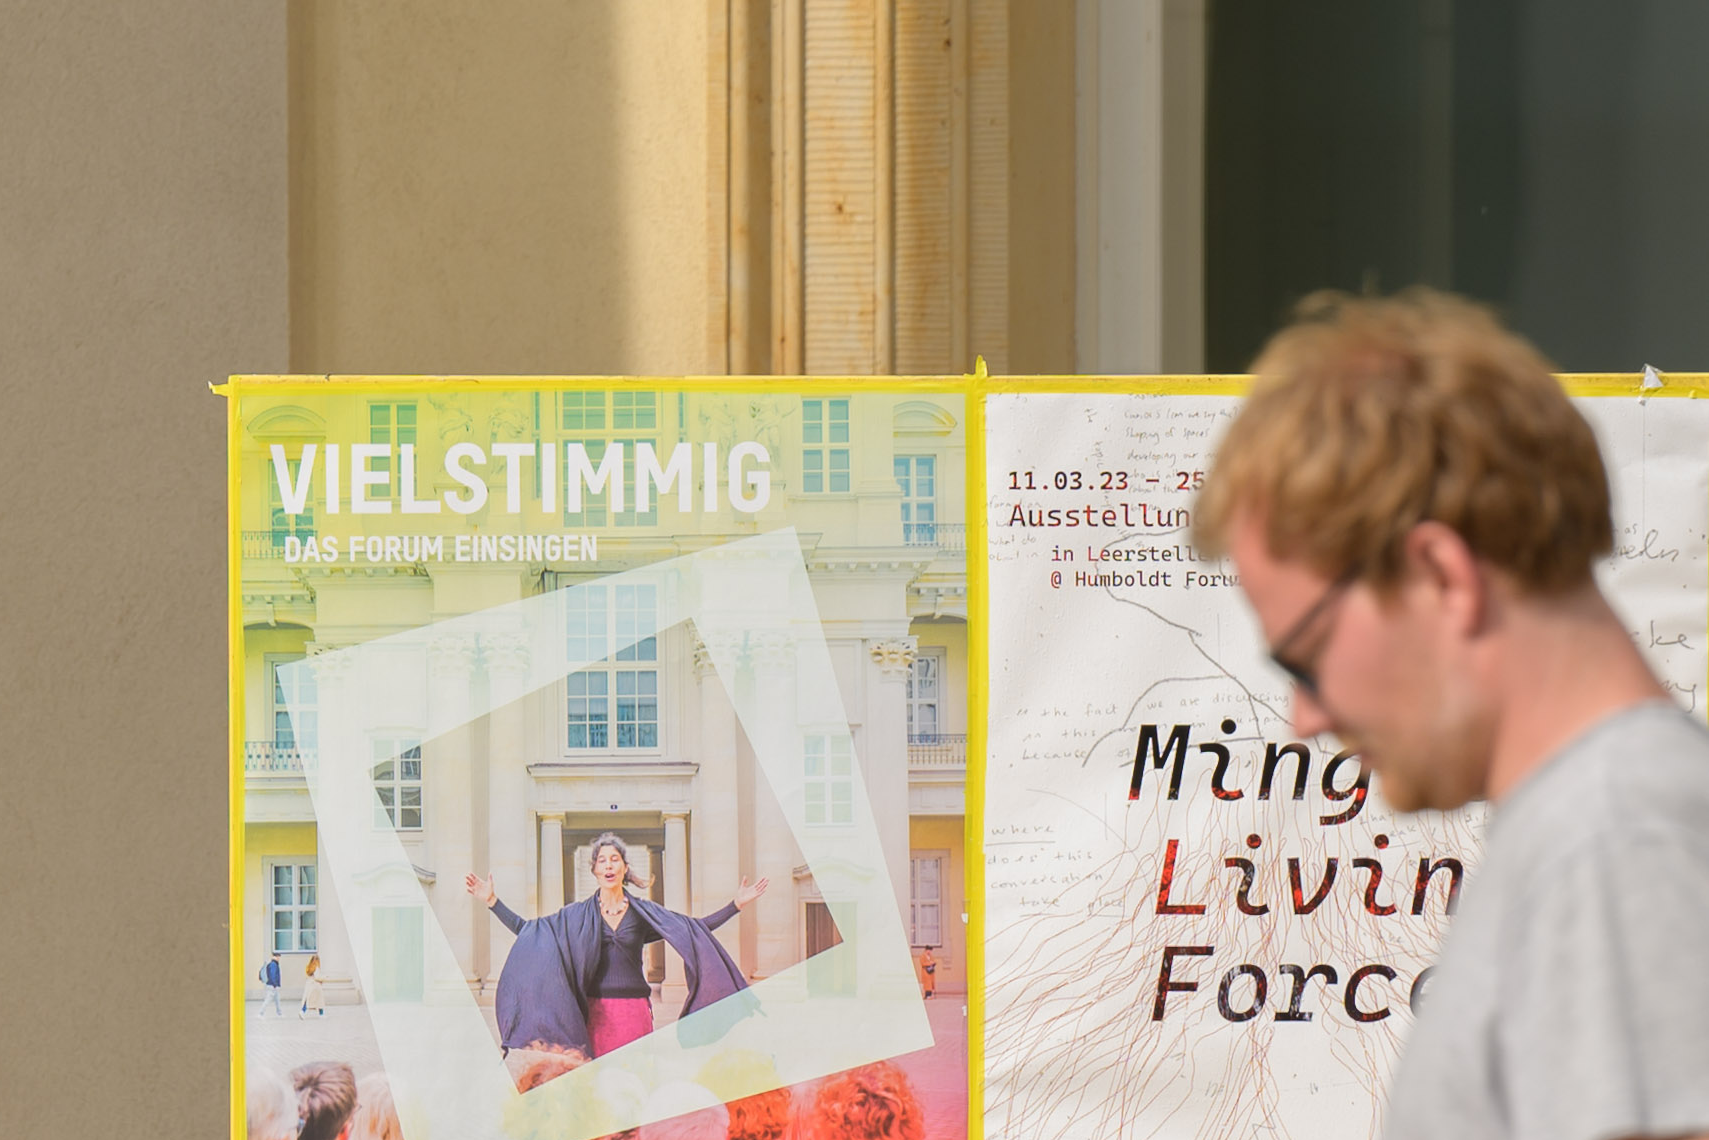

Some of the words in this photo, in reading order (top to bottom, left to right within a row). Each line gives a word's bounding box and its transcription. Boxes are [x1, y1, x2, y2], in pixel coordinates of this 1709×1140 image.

[269, 441, 772, 515] VIELSTIMMIG
[1008, 471, 1128, 490] 11.03.23
[1009, 503, 1191, 528] Ausstellun
[284, 535, 339, 564] DAS
[348, 534, 444, 563] FORUM
[454, 534, 598, 563] EINSINGEN
[1051, 545, 1074, 562] in
[1050, 570, 1062, 589] @
[1075, 570, 1172, 587] Humboldt
[1128, 718, 1372, 826] Ming
[1155, 833, 1465, 917] Livin
